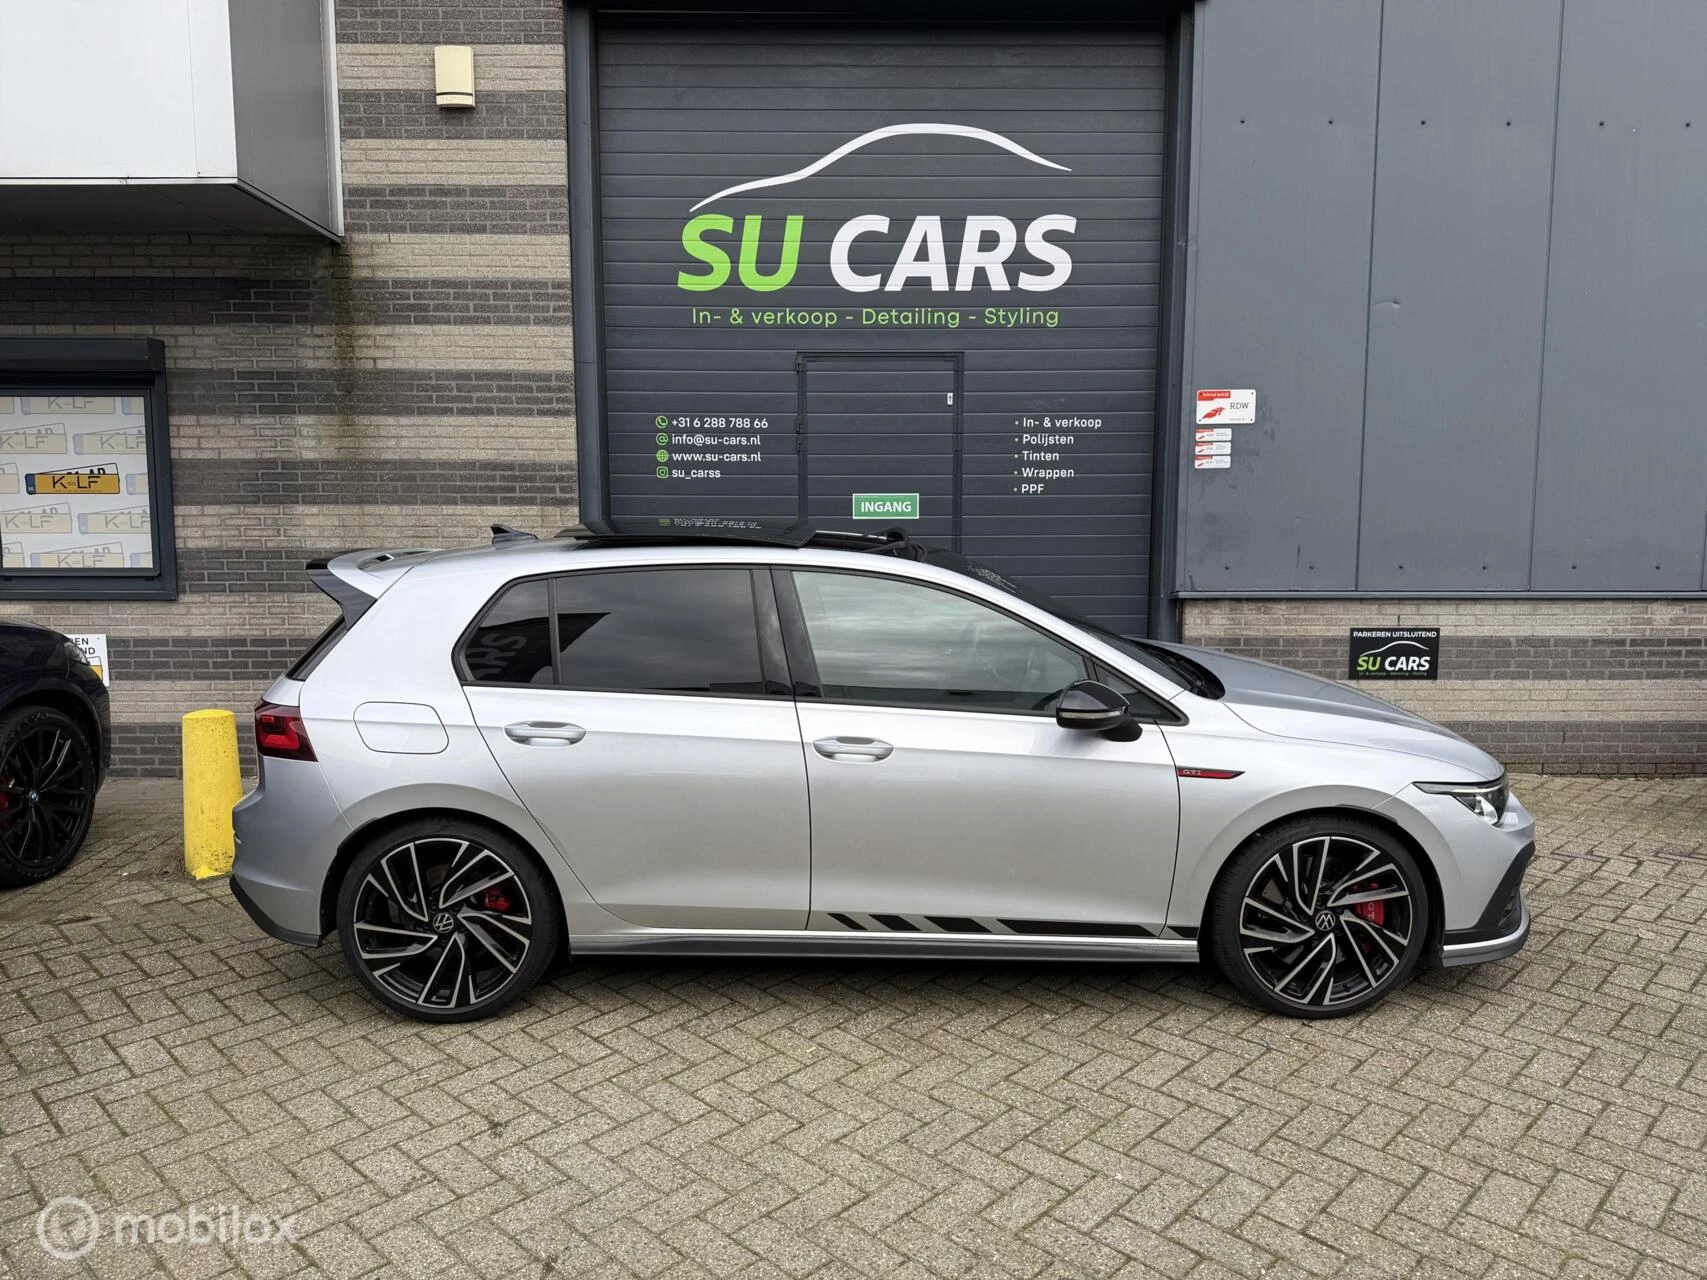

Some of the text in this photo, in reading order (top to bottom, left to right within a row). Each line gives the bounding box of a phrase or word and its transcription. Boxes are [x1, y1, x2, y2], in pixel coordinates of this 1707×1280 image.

[677, 213, 1077, 293] SU CARS
[692, 308, 721, 325] In-
[729, 308, 744, 325] &
[752, 308, 838, 328] verkoop
[862, 308, 960, 328] Detailing
[984, 308, 1059, 328] Styling
[1230, 401, 1249, 410] RDW
[671, 417, 768, 429] +31 6 288 788 66
[1023, 416, 1102, 429] In- & verkoop
[671, 434, 761, 446] info@su-cars.nl
[1022, 434, 1074, 446] Polijsten
[671, 452, 762, 462] www.su-cars.nl
[1022, 450, 1060, 461] Tinten
[671, 469, 721, 480] su_carss
[1021, 467, 1075, 479] Wrappen
[1021, 484, 1045, 494] PPF
[861, 501, 912, 512] INGANG
[1357, 656, 1431, 671] SU CARS
